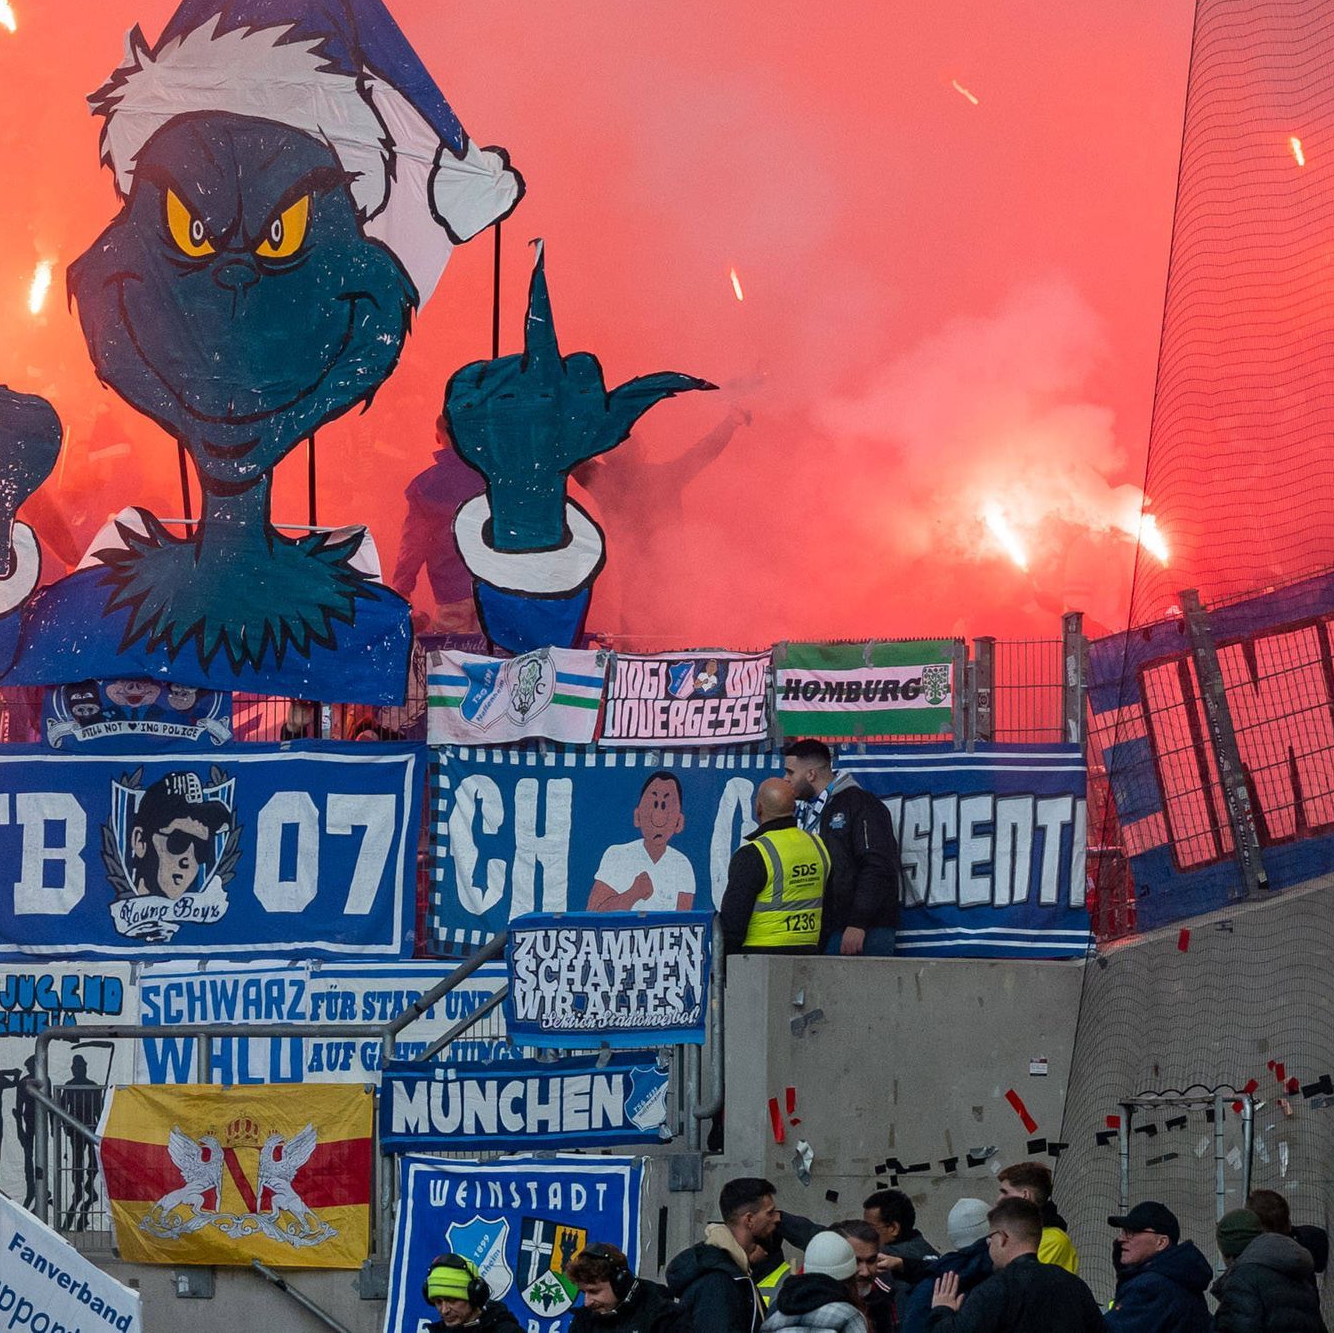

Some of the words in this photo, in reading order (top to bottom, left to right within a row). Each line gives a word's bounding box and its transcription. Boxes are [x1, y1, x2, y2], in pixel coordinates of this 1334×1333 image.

[781, 676, 924, 705] HOMBURG
[82, 725, 103, 739] STILL
[105, 723, 123, 733] NOT
[162, 724, 199, 739] POLICE
[604, 695, 767, 738] UNVERGESSE
[254, 792, 402, 915] 07
[792, 863, 817, 878] SDS
[120, 897, 168, 927] Young
[784, 912, 816, 932] 1236
[514, 926, 705, 961] ZUSAMMEN
[515, 953, 705, 993] SCHAFFEN
[141, 978, 307, 1027] SCHWARZ
[309, 984, 358, 1021] FÜR
[515, 979, 574, 1021] WIR
[541, 1010, 597, 1029] Sektion
[308, 1041, 356, 1072] AUF
[392, 1068, 624, 1134] MÜNCHEN
[429, 1179, 608, 1212] WEINSTADT
[472, 1233, 491, 1259] 1899
[8, 1231, 134, 1333] Fanverband
